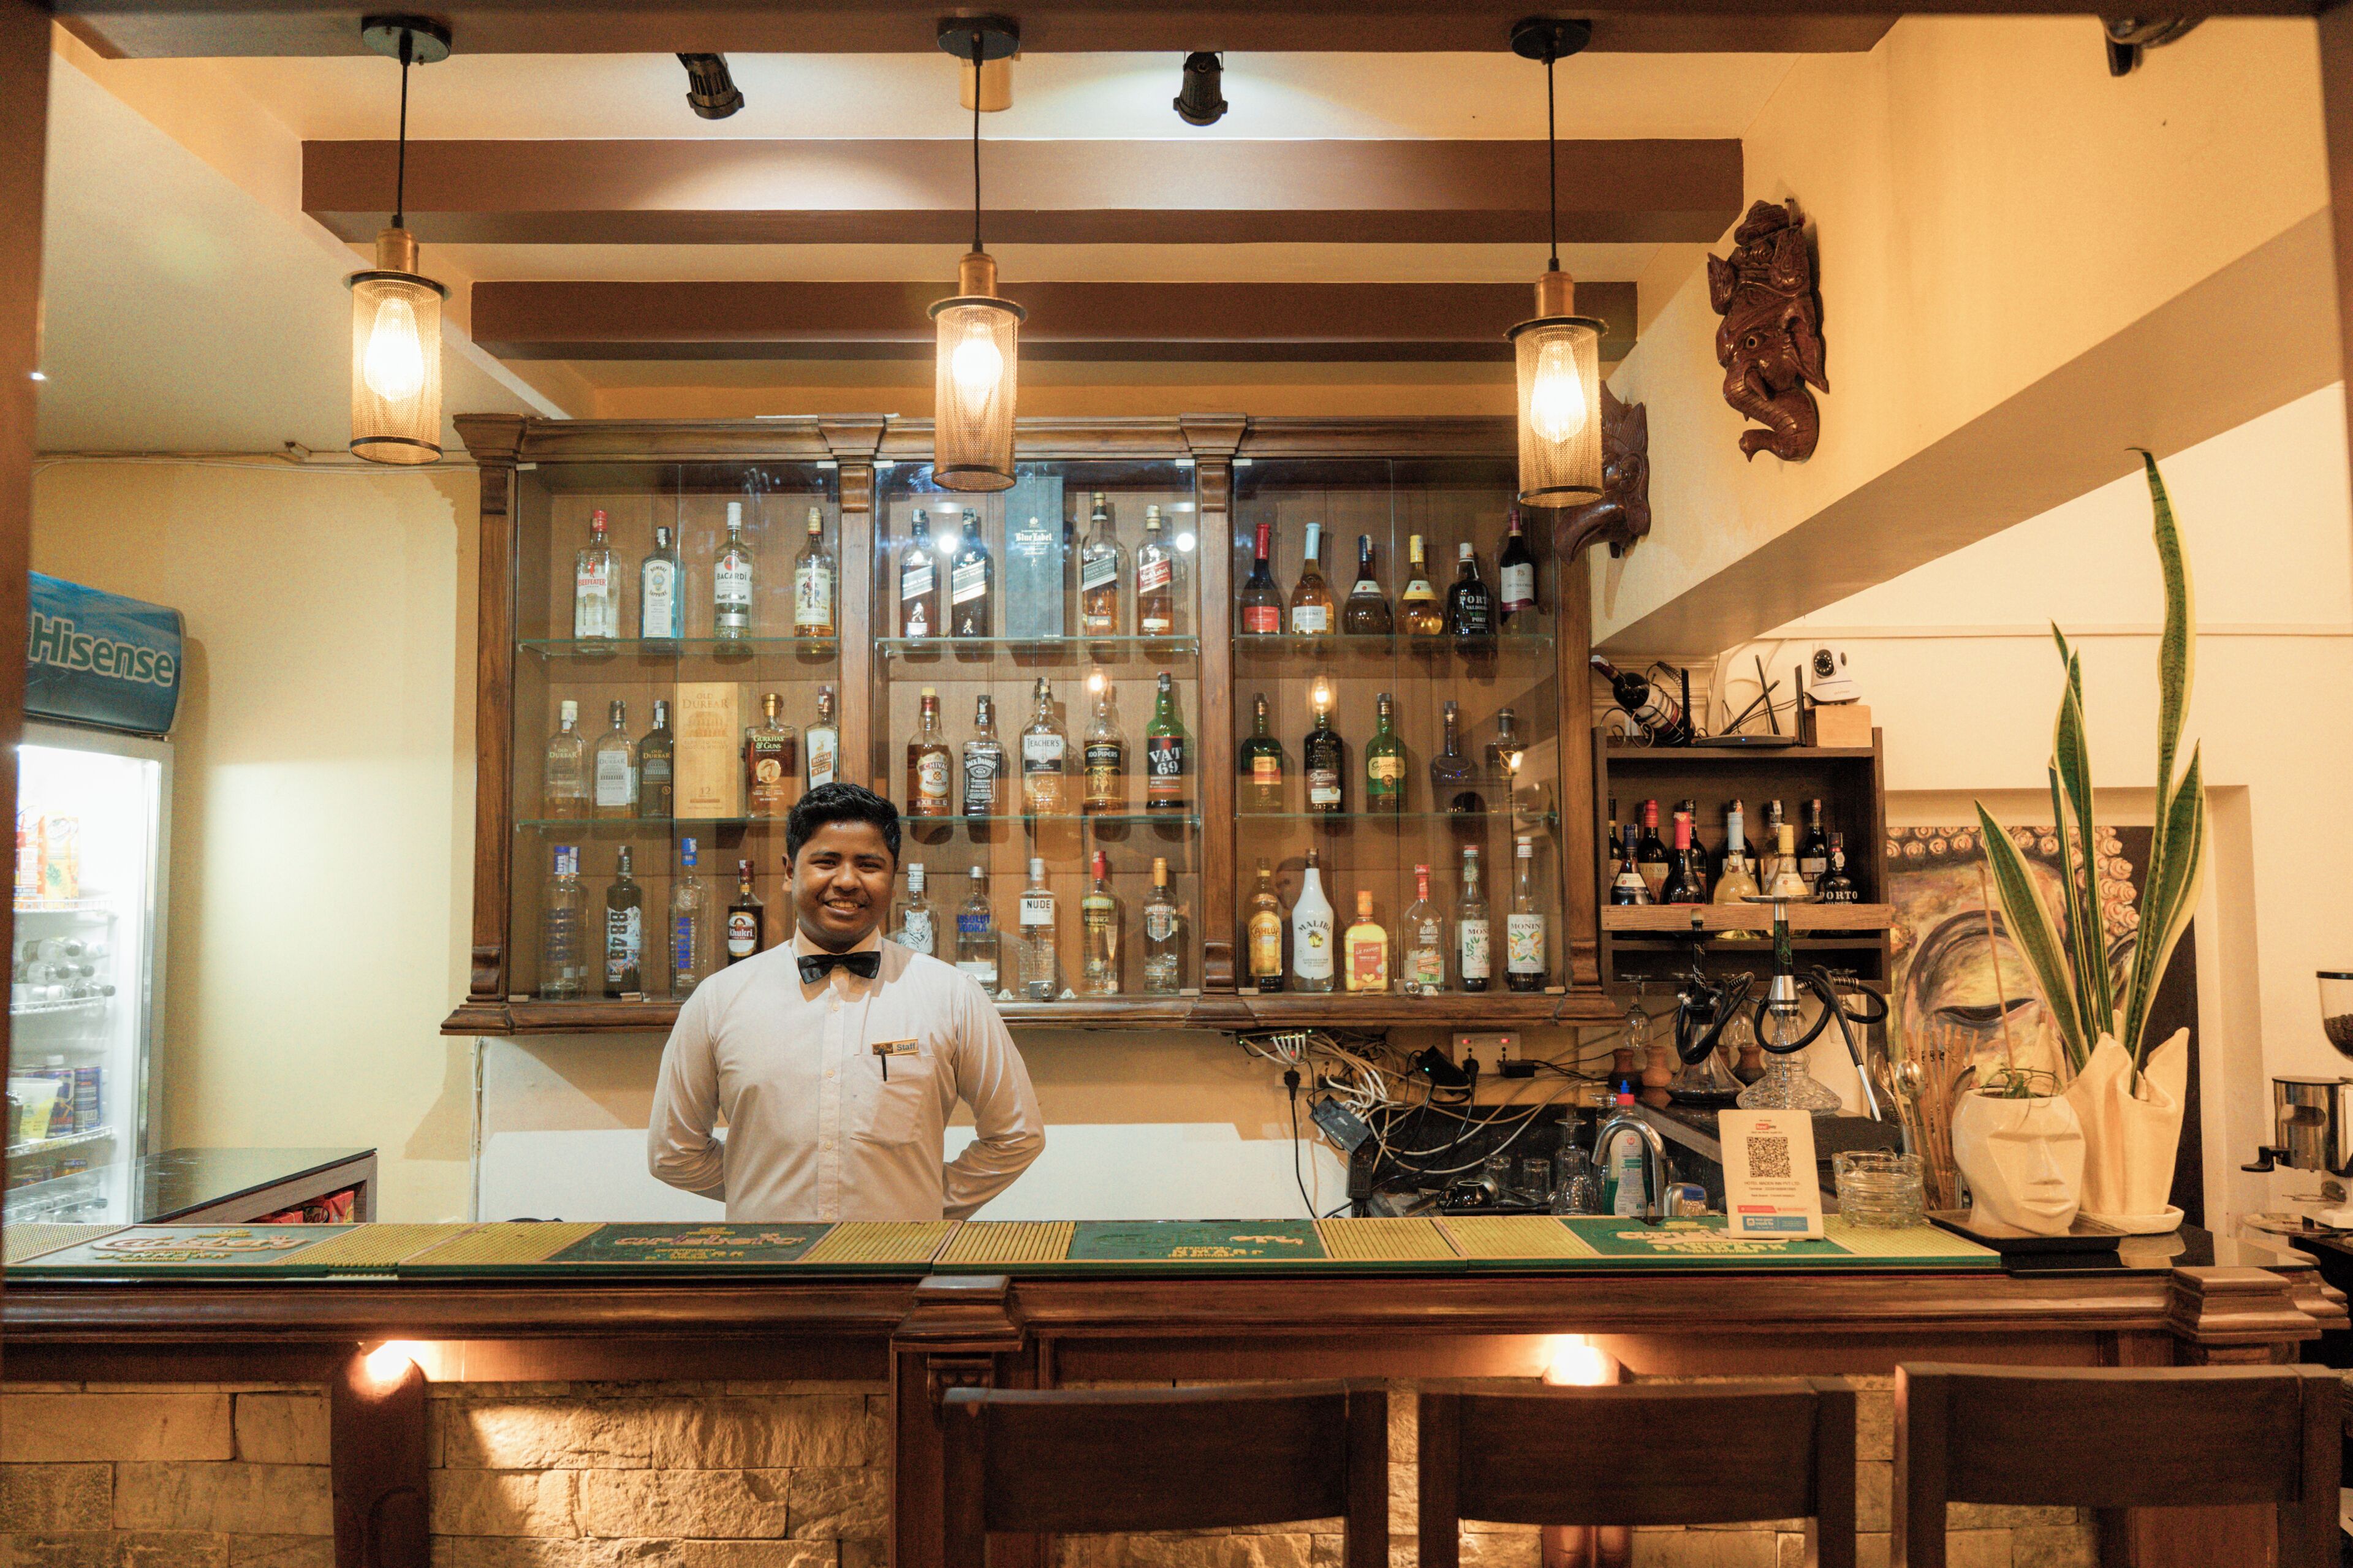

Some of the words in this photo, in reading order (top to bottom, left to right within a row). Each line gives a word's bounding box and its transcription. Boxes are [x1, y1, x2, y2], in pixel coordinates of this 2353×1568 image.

[1015, 532, 1032, 542] Blue
[717, 572, 747, 580] BACARDÍ
[1460, 596, 1488, 604] PORT
[29, 612, 175, 687] Hisense
[1028, 738, 1059, 749] TEACHER'S
[812, 754, 831, 763] ROYAL
[1149, 747, 1182, 763] VAT
[924, 762, 948, 770] CHIVAS
[966, 759, 977, 768] JACK
[977, 757, 997, 769] DANIEL'S
[1819, 891, 1858, 900] PORTO
[1027, 900, 1051, 909] NUDE
[611, 912, 627, 960] 8848
[678, 917, 691, 969] RUSLAN
[92, 1235, 311, 1252] Carlsberg
[615, 1232, 806, 1246] arlsberg
